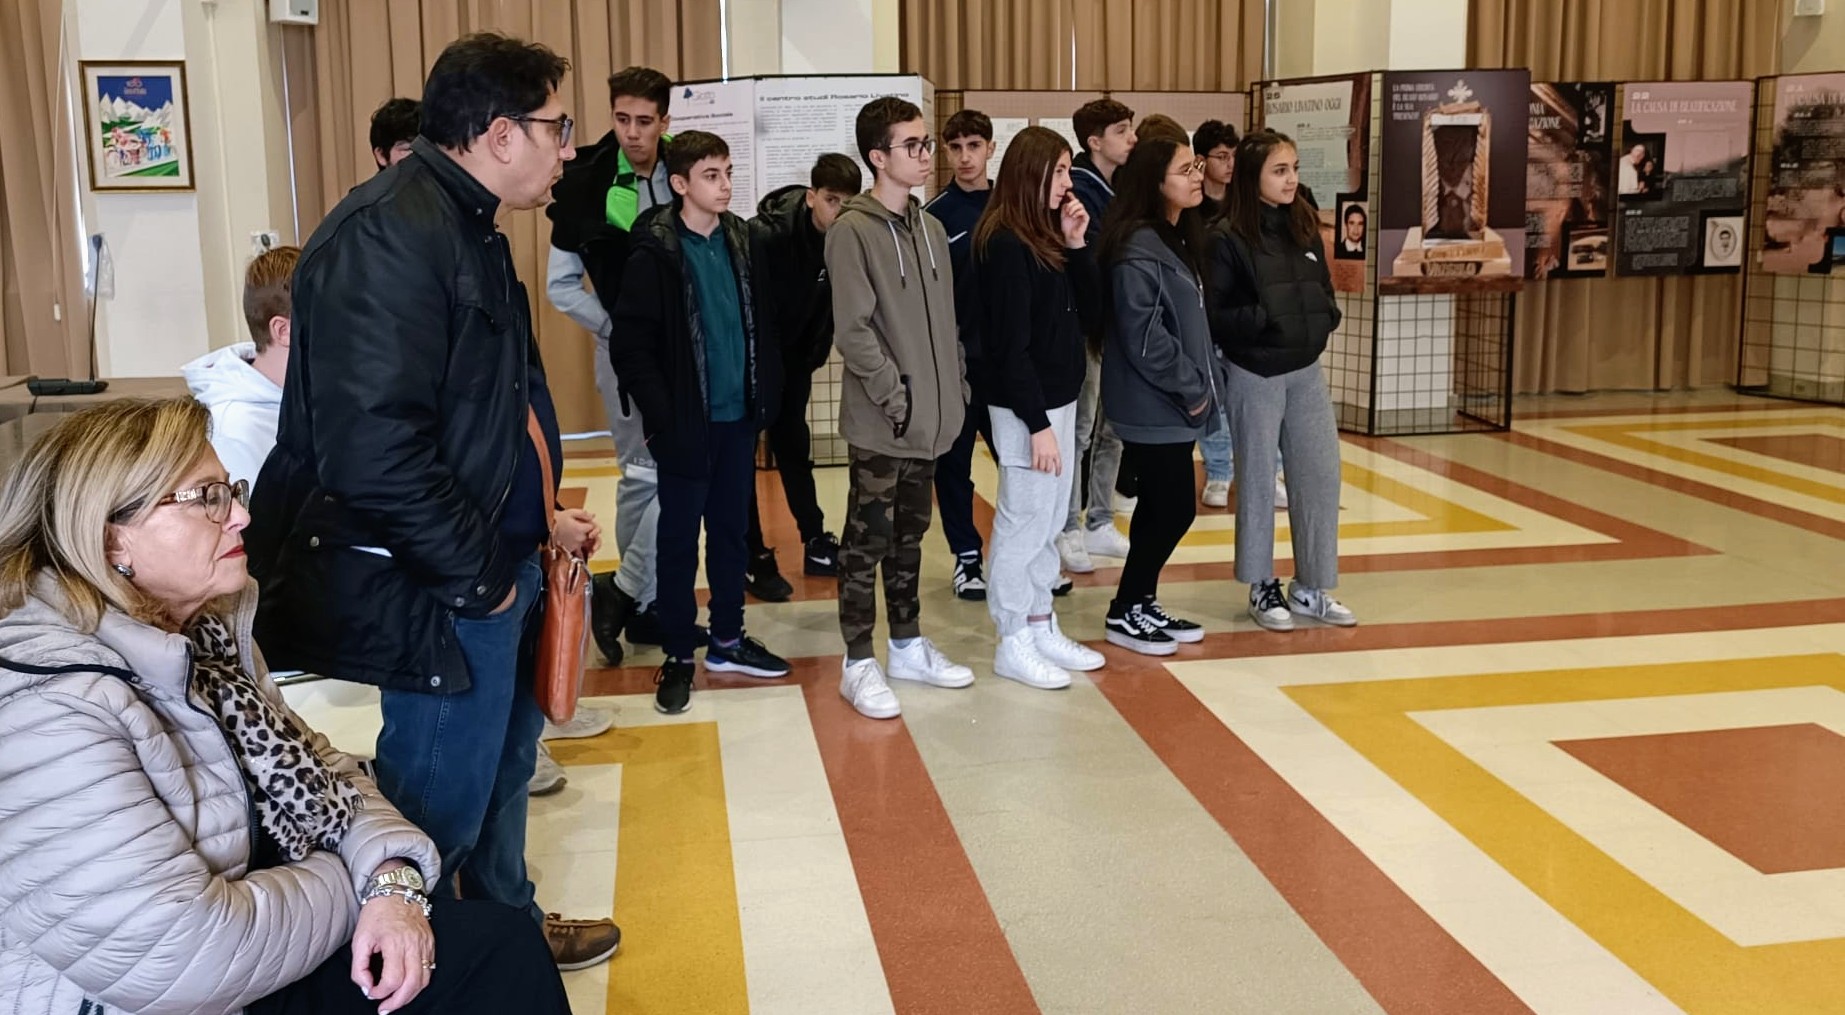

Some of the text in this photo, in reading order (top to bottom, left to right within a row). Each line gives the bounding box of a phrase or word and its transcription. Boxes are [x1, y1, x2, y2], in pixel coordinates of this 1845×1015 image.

[1265, 97, 1341, 115] ROSARIO LIVATINO OGGI
[1631, 99, 1737, 114] LA CAUSA DI BEATIFICAZIONE
